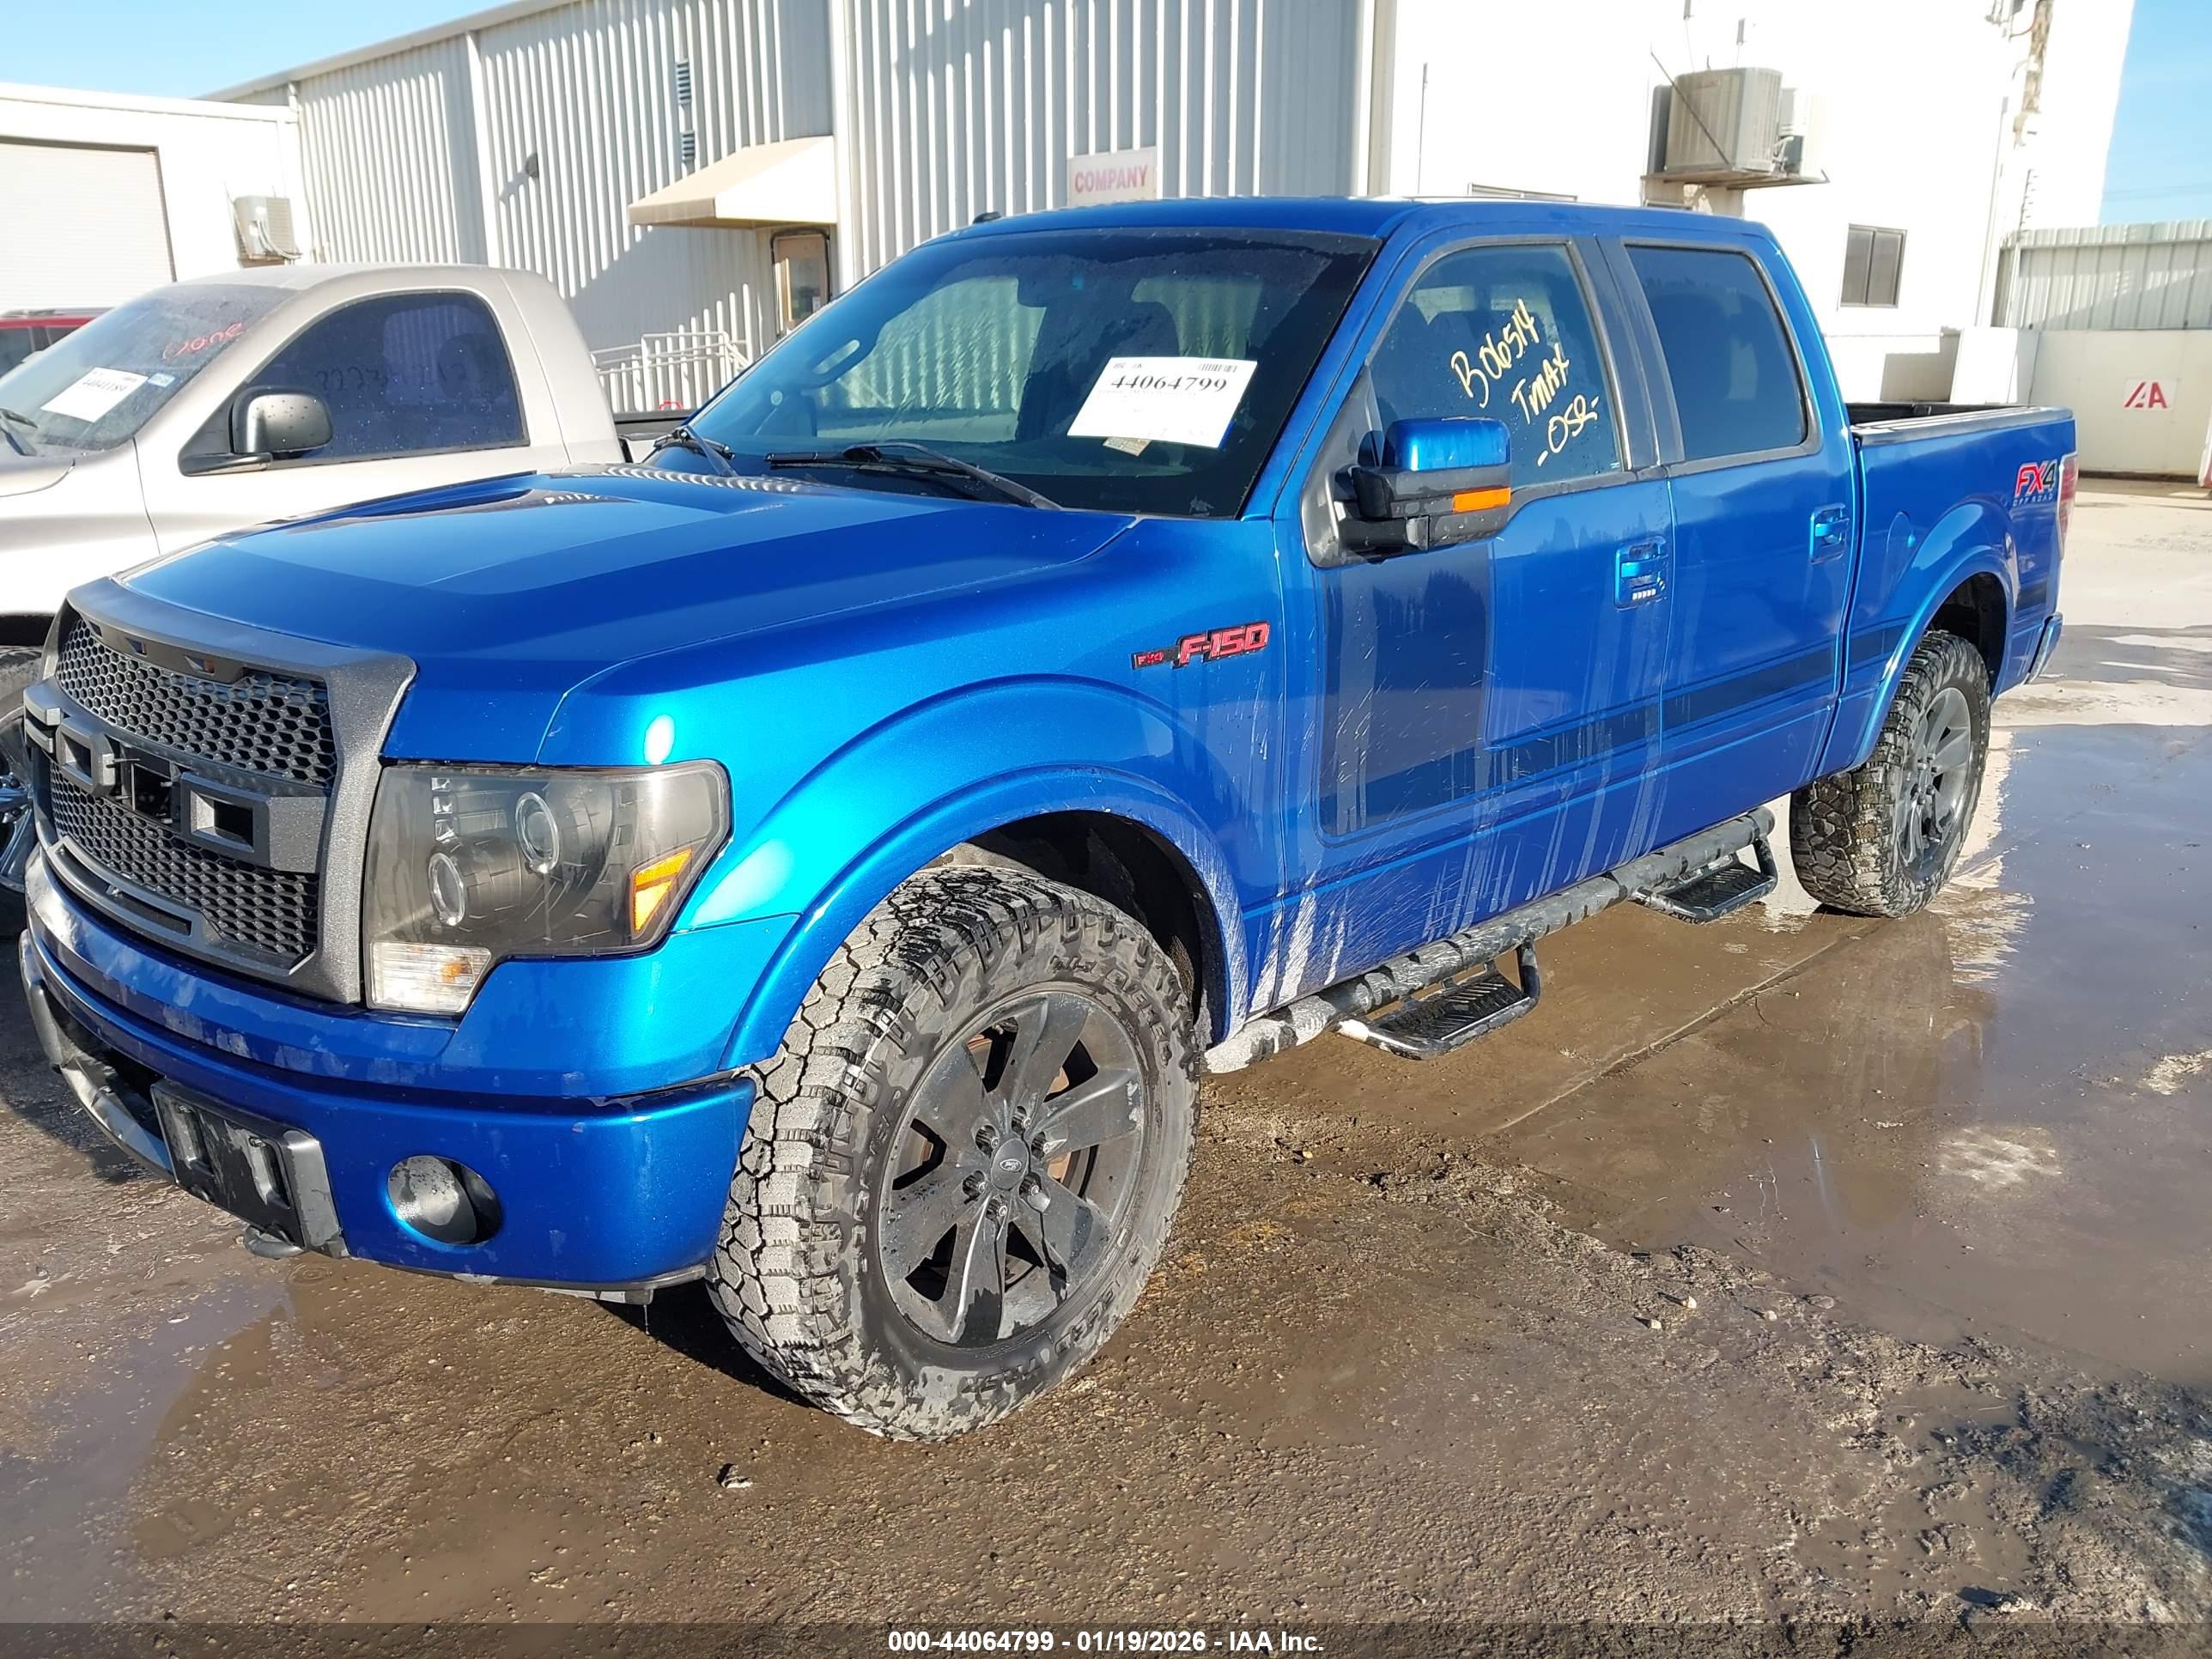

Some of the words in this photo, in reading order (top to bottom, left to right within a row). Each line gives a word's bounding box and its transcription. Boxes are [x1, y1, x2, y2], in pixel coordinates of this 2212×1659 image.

[1074, 165, 1149, 194] COMPANY
[1111, 374, 1228, 393] 44064799
[2014, 459, 2058, 498] FX4
[1176, 621, 1270, 666] F-150
